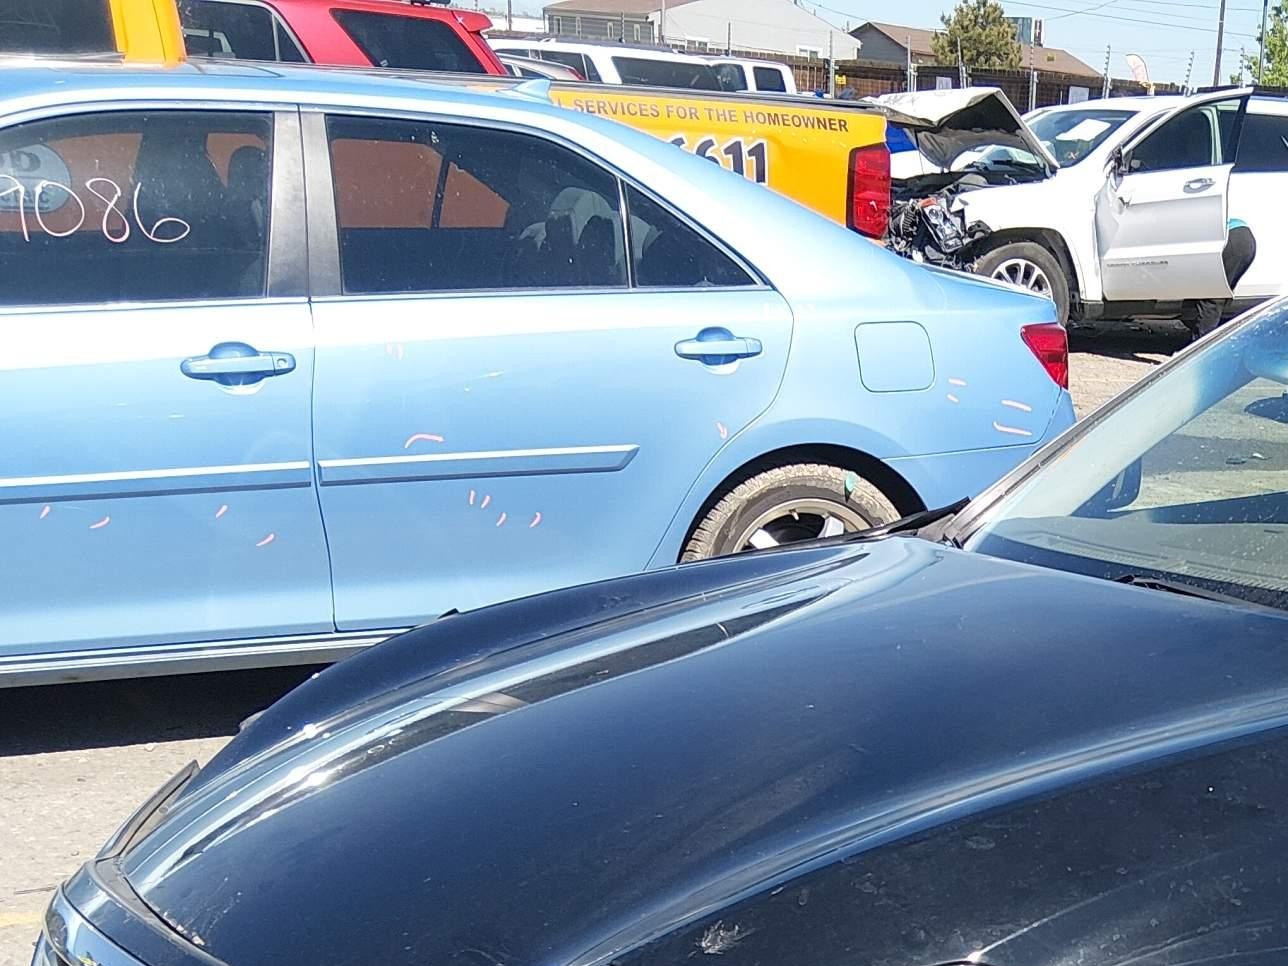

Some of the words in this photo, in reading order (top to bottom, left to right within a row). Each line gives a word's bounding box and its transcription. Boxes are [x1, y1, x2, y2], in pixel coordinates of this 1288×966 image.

[573, 98, 660, 118] SERVICES
[666, 105, 700, 121] FOR
[704, 107, 738, 123] THE
[743, 111, 849, 133] HOMEOWNER
[666, 136, 767, 184] 611
